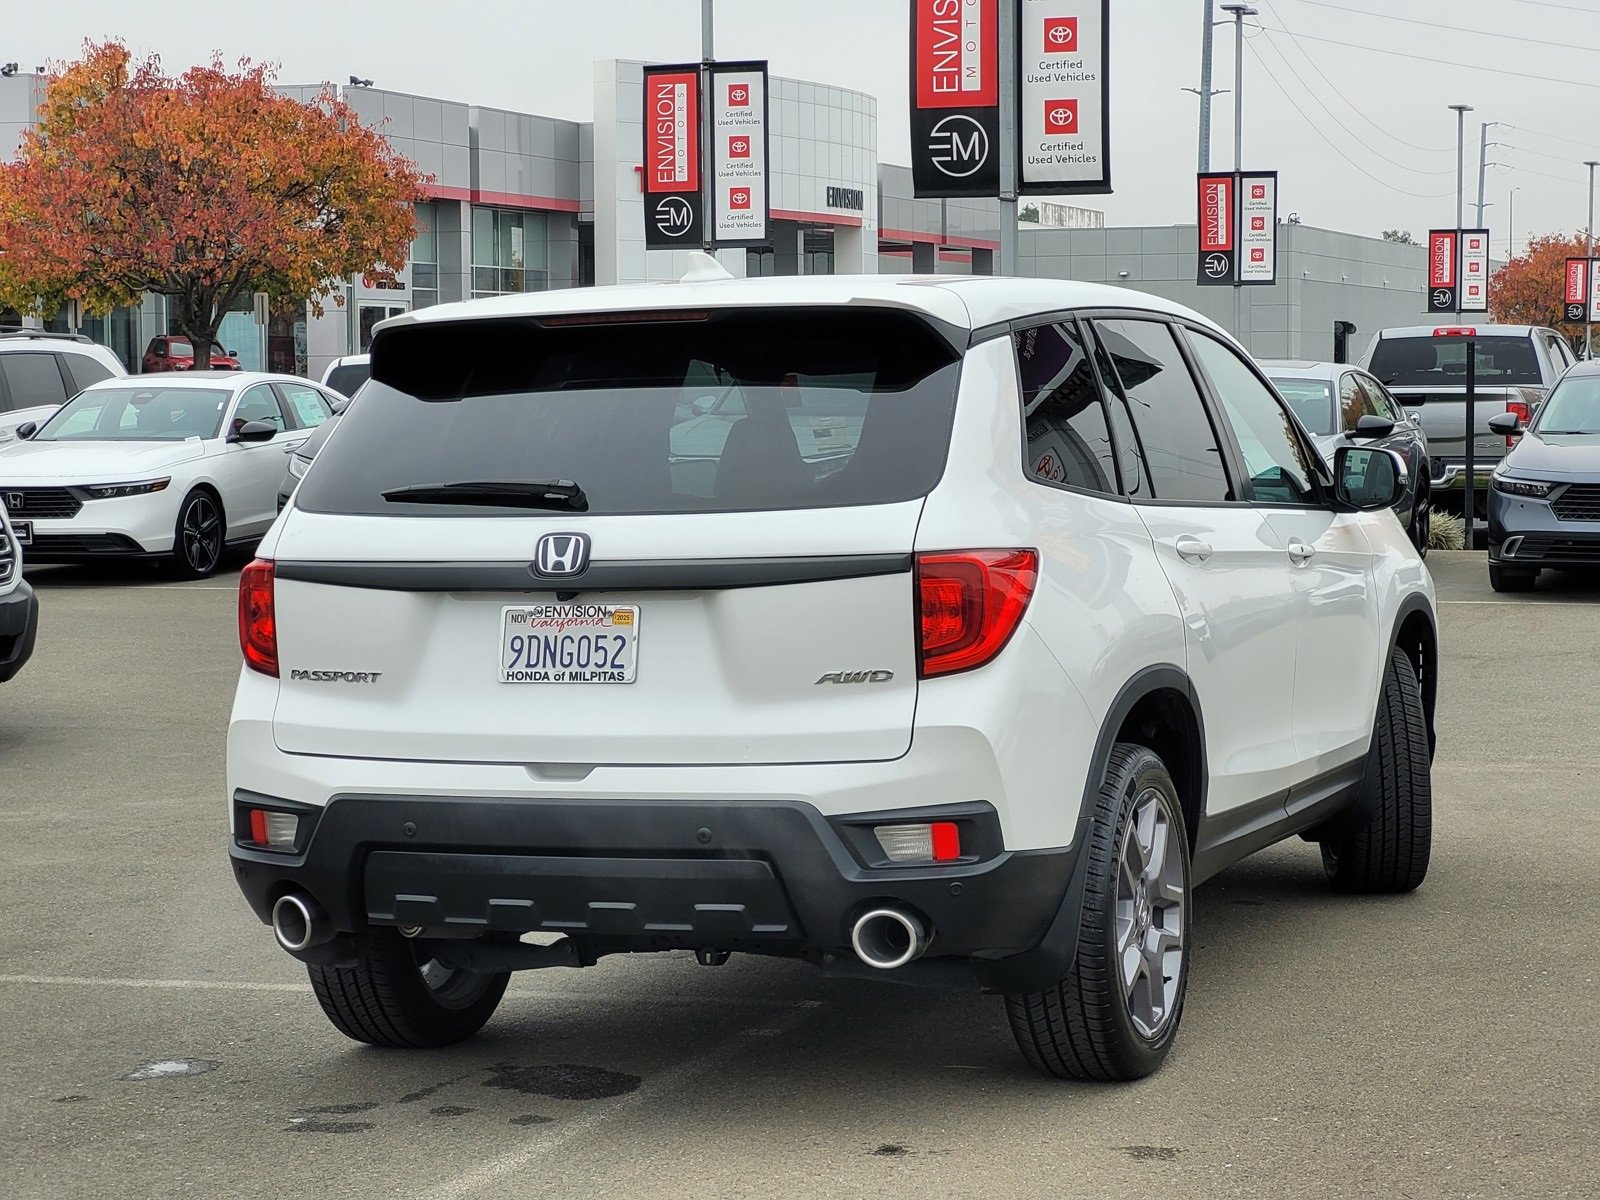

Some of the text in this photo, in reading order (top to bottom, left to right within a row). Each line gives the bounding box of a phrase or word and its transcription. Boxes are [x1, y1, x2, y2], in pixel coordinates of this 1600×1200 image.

[1039, 60, 1083, 70] Certified
[1027, 72, 1096, 83] Used Vehicles
[657, 83, 674, 183] ENVISION
[1040, 142, 1083, 152] Certified
[1028, 154, 1097, 165] Used Vehicles
[827, 186, 863, 210] ENVISION
[1206, 184, 1218, 245] ENVISION
[1435, 237, 1443, 283] ENVISION
[1569, 264, 1577, 300] ENVISION
[511, 614, 528, 623] NOV
[545, 606, 607, 617] ENVISION
[531, 617, 612, 633] California
[508, 635, 627, 669] 9DNG052
[290, 669, 382, 683] PASSPORT
[506, 671, 625, 681] HONDA of MILPITAS
[814, 668, 894, 684] AWD
